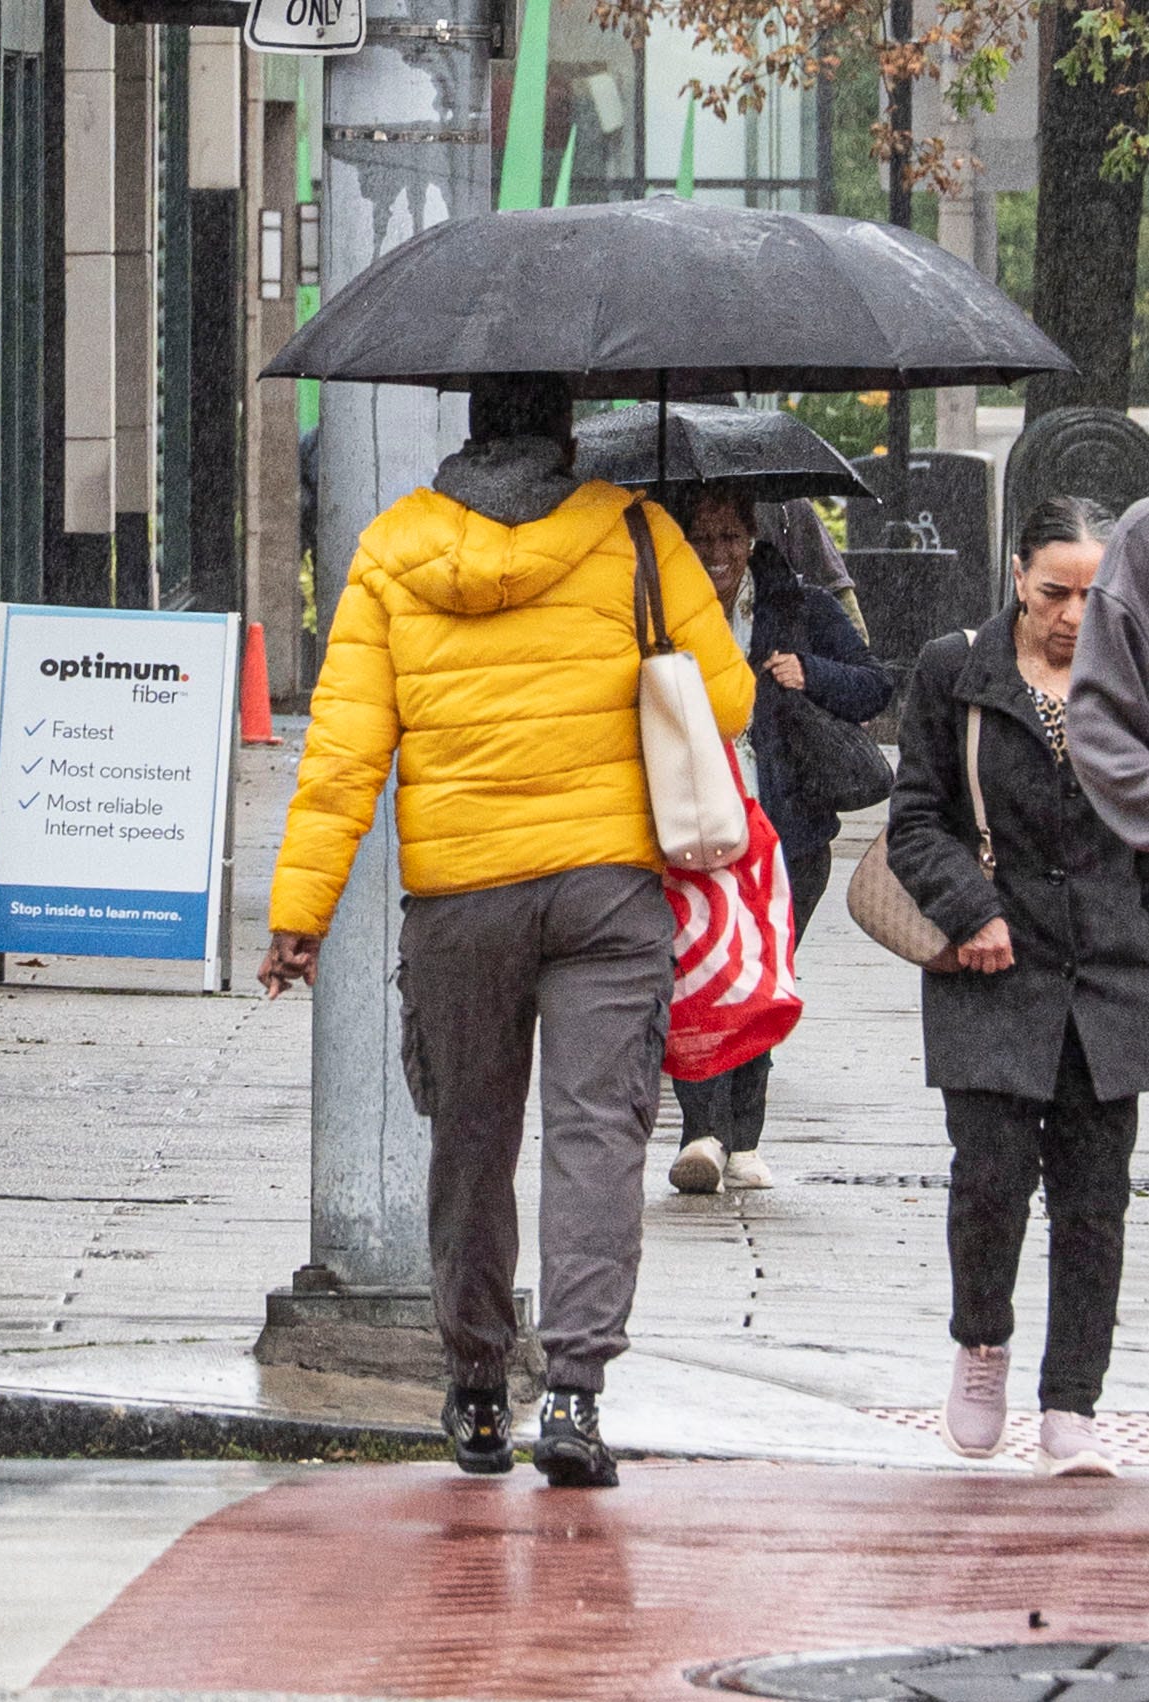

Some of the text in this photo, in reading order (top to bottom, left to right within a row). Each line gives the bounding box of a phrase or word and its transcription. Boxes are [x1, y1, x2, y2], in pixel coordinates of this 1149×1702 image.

[286, 0, 343, 25] ONLY
[132, 684, 179, 704] fiber
[52, 720, 114, 740] Fastest
[49, 759, 192, 782] Most consistent
[46, 793, 163, 815] Most reliable
[44, 818, 185, 842] Internet speeds
[10, 901, 182, 922] Stop inside to learn more.
